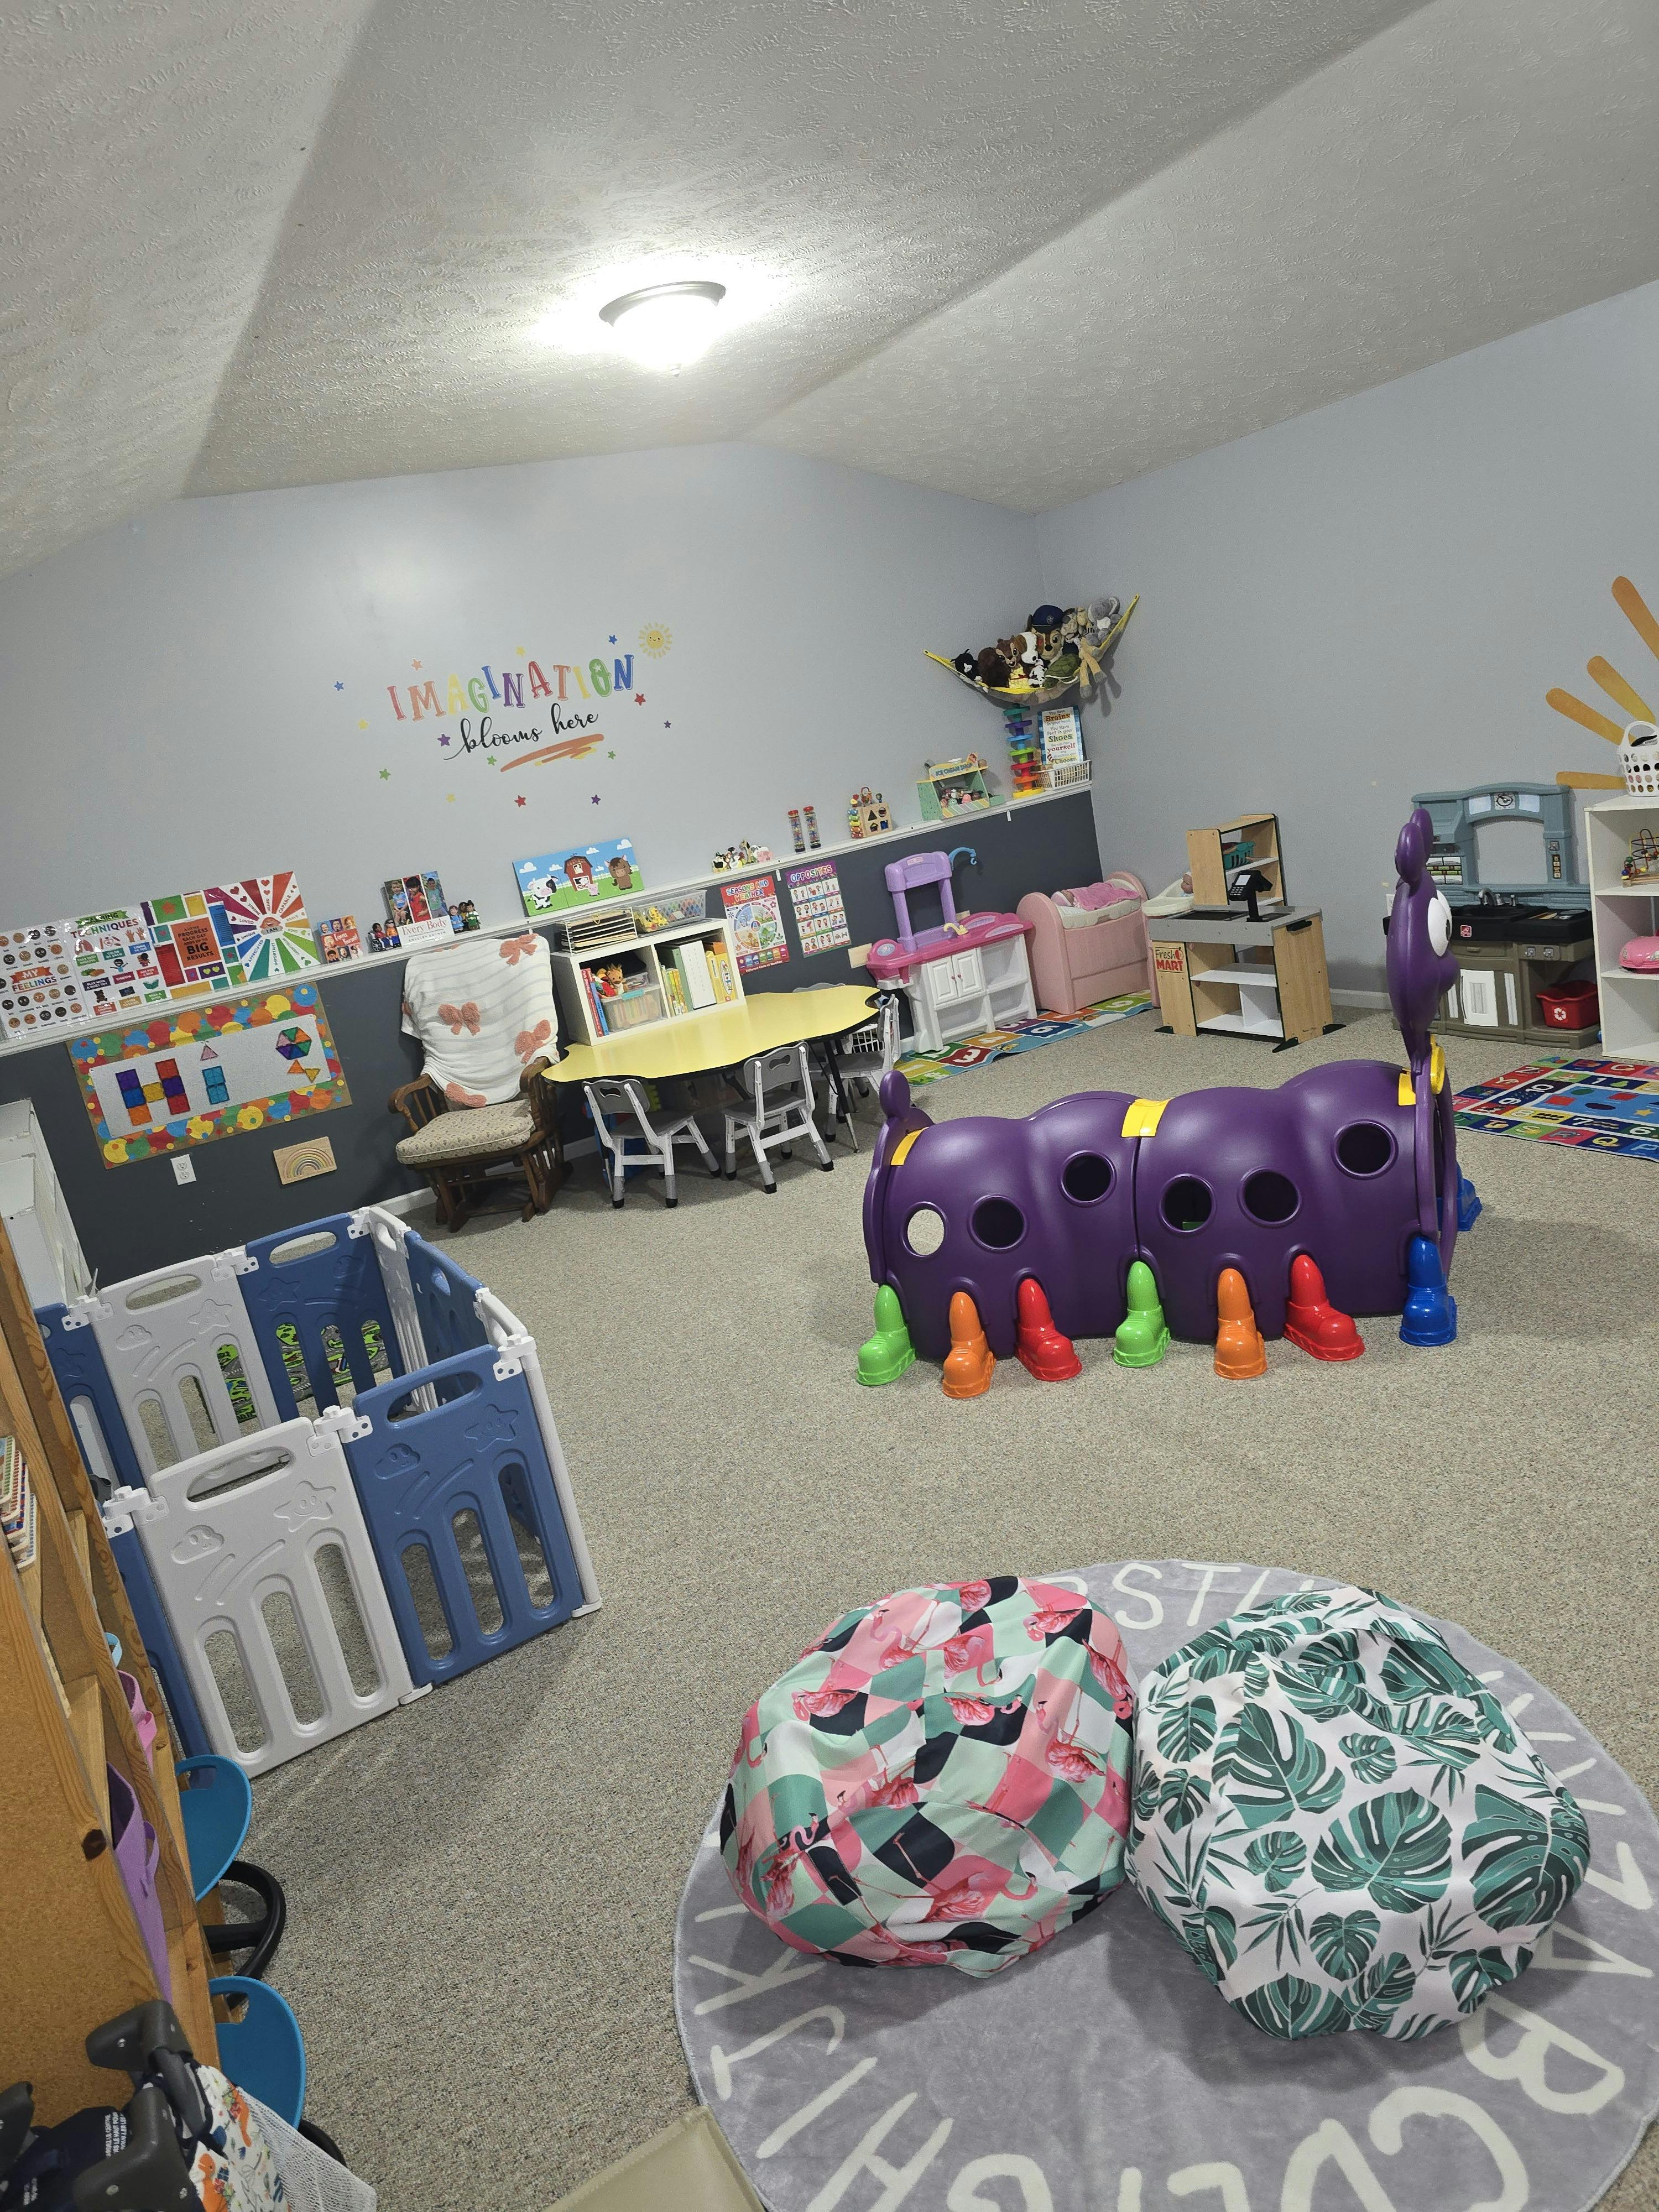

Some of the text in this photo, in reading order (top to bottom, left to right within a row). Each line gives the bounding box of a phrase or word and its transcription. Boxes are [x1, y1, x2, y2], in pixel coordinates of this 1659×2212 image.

[387, 654, 634, 721] IMAGINATION
[1046, 713, 1070, 722] Brains
[443, 703, 599, 760] blooms here
[1048, 734, 1073, 742] Shoes
[1047, 743, 1076, 753] yourself
[790, 864, 832, 883] OPPOSITES
[726, 879, 769, 895] SEASONS AND
[734, 889, 764, 902] WEATHER
[278, 895, 291, 914] CAPABLE
[178, 927, 208, 938] PROGRESS
[401, 925, 425, 936] Every
[426, 918, 447, 930] Body
[186, 942, 209, 954] BIG
[248, 940, 264, 963] APPRECIATED
[1155, 950, 1176, 959] Fresh
[1156, 959, 1183, 971] MART
[22, 969, 39, 979] MY
[12, 976, 57, 992] FEELINGS
[1031, 1025, 1060, 1034] 6
[953, 1049, 980, 1063] 3
[1525, 1084, 1554, 1093] 10
[1629, 1126, 1656, 1135] 6
[1592, 1136, 1620, 1147] Q
[1112, 1563, 1164, 1630] S
[1181, 1563, 1241, 1627] T
[687, 1945, 827, 2016] K
[1458, 1992, 1626, 2116] B
[807, 2092, 954, 2212] H
[1369, 2085, 1530, 2212] C
